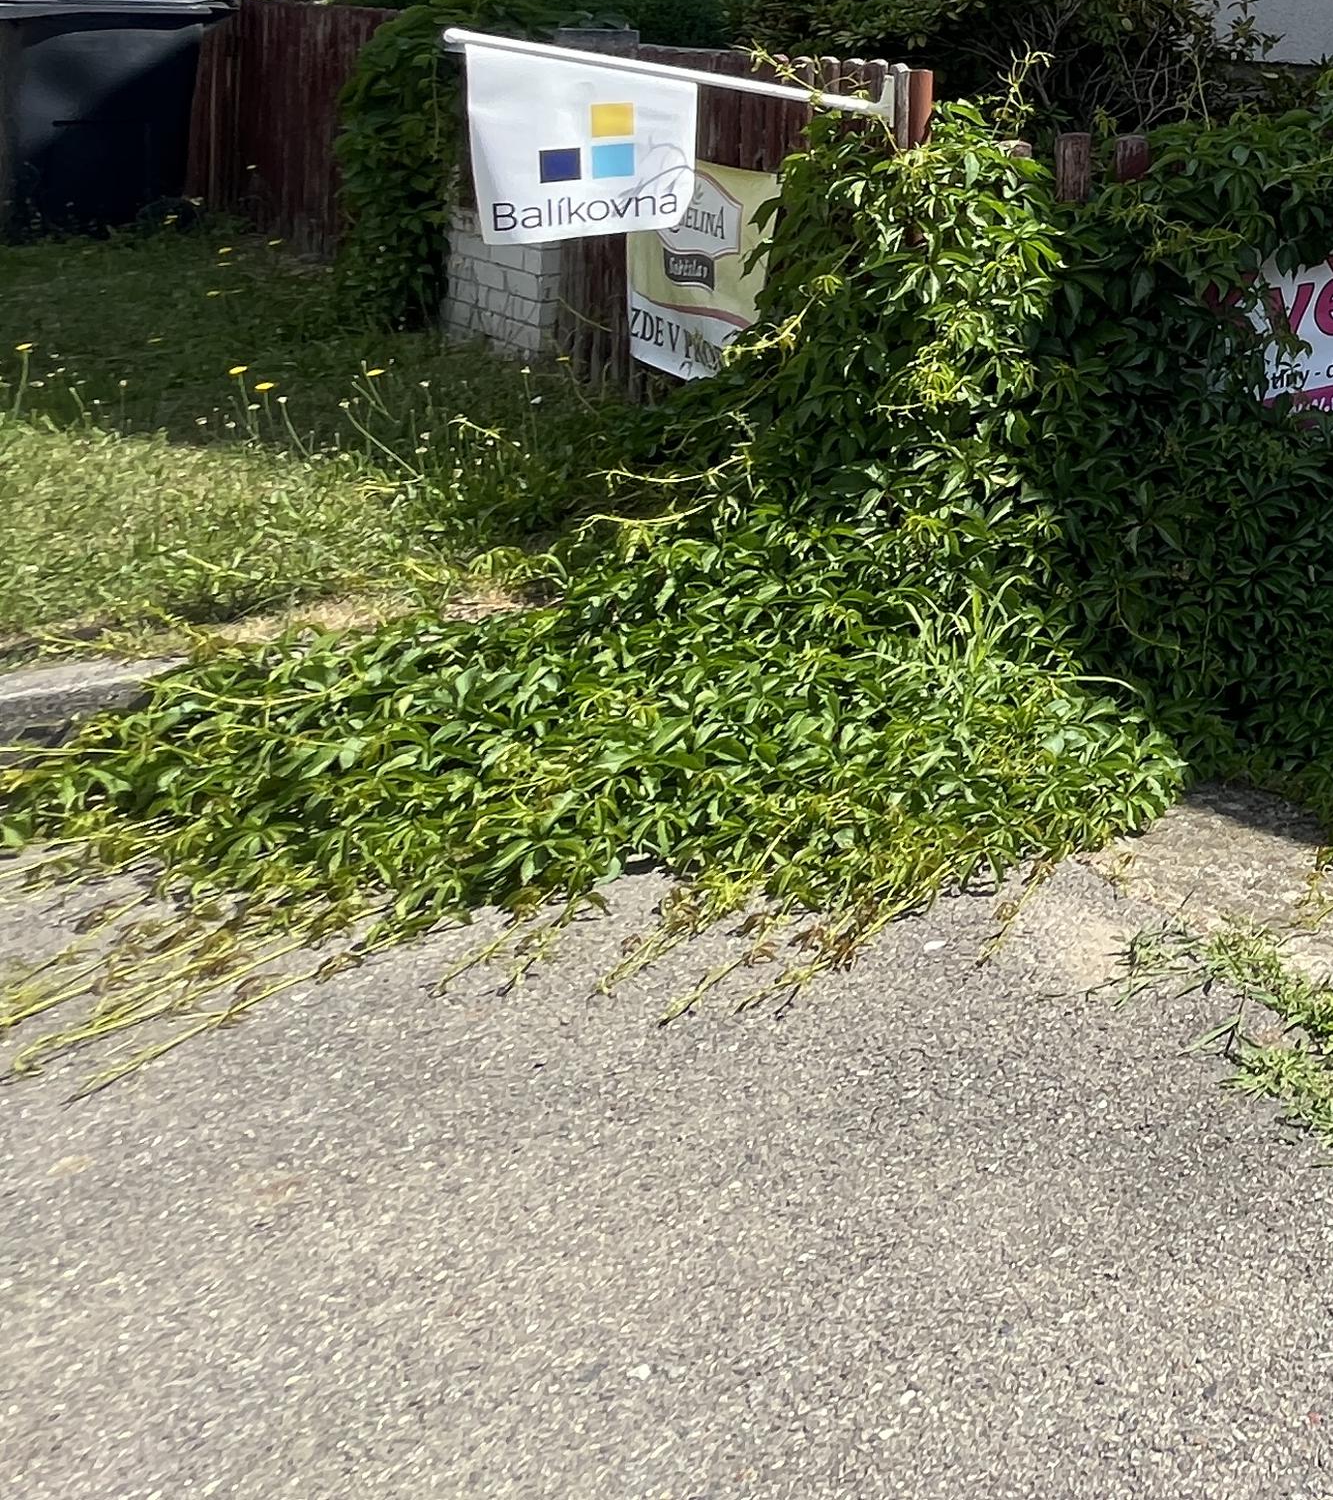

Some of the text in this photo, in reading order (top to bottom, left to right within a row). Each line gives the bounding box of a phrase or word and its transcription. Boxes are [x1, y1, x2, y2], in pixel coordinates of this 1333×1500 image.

[491, 193, 677, 232] Balíkovna
[668, 205, 725, 240] ELINA
[630, 307, 664, 347] ZDE
[667, 321, 681, 352] V
